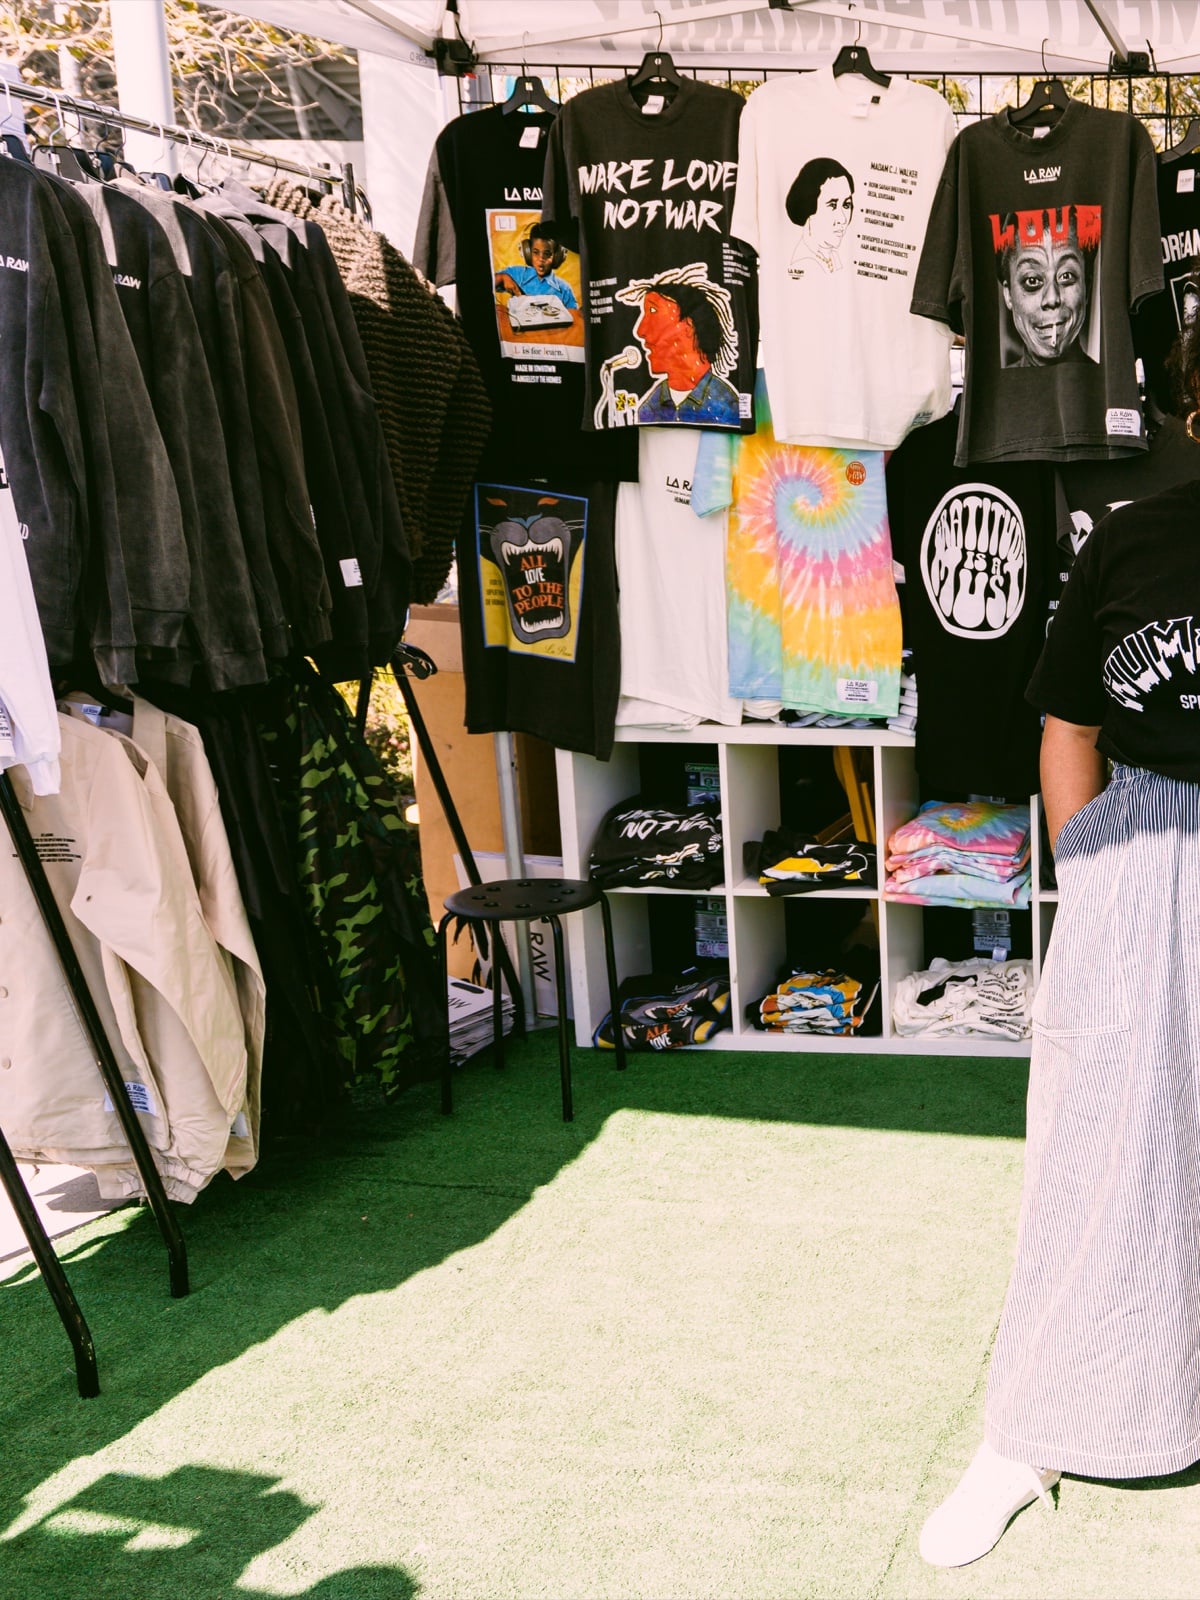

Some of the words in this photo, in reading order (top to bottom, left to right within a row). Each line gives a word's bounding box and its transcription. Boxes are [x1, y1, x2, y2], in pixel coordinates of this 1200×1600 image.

[577, 159, 655, 195] MAKE
[661, 159, 738, 191] LOVE
[1024, 169, 1037, 181] LA
[1038, 166, 1062, 179] RAW
[504, 187, 521, 202] LA
[603, 198, 664, 230] NOT
[665, 199, 724, 234] WAR
[666, 476, 680, 488] LA
[521, 554, 547, 571] ALL
[963, 551, 987, 572] IS
[524, 567, 546, 585] LOVE
[512, 584, 533, 601] TO
[537, 581, 564, 596] THE
[513, 594, 564, 616] PEOPLE
[619, 819, 680, 840] NOT
